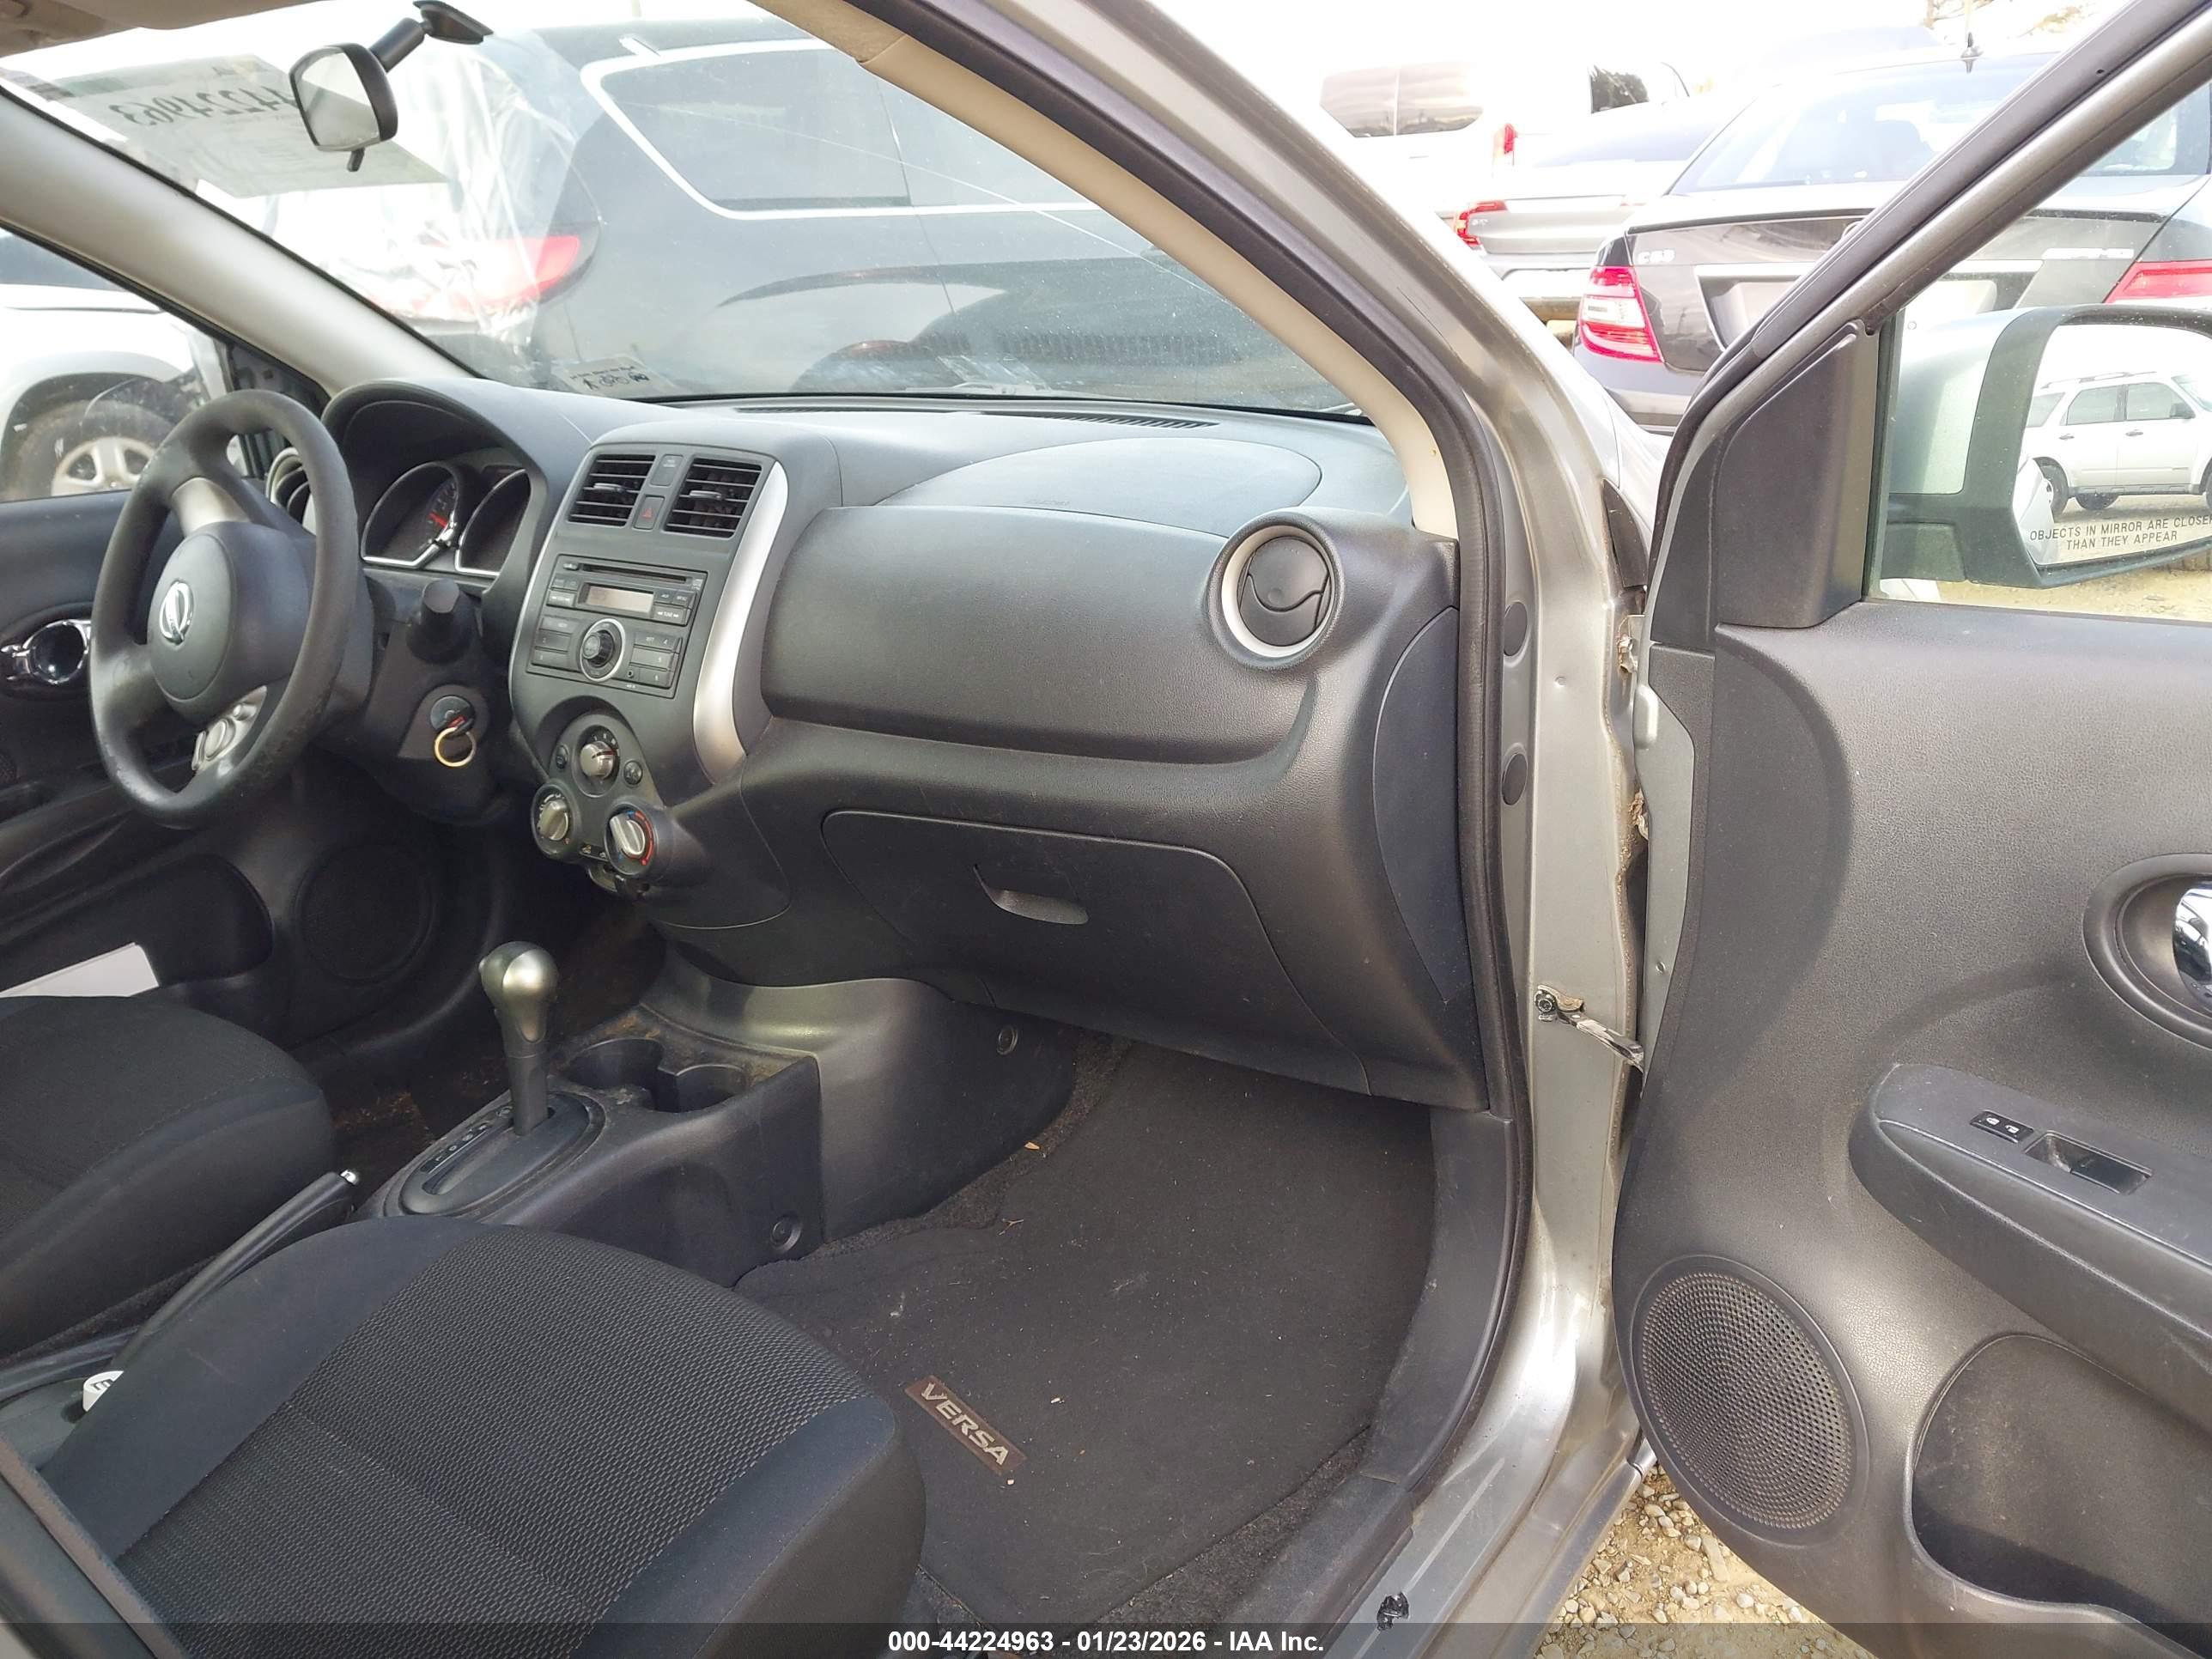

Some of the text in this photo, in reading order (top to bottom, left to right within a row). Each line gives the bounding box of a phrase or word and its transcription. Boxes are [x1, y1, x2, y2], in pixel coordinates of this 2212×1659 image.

[2030, 527, 2081, 541] OBJECTS
[2086, 526, 2096, 537] IN
[2100, 521, 2142, 534] MIRROR
[2147, 519, 2169, 530] ARE
[2067, 531, 2178, 550] THAN THEY APPEAR
[921, 1382, 1010, 1465] VERSA
